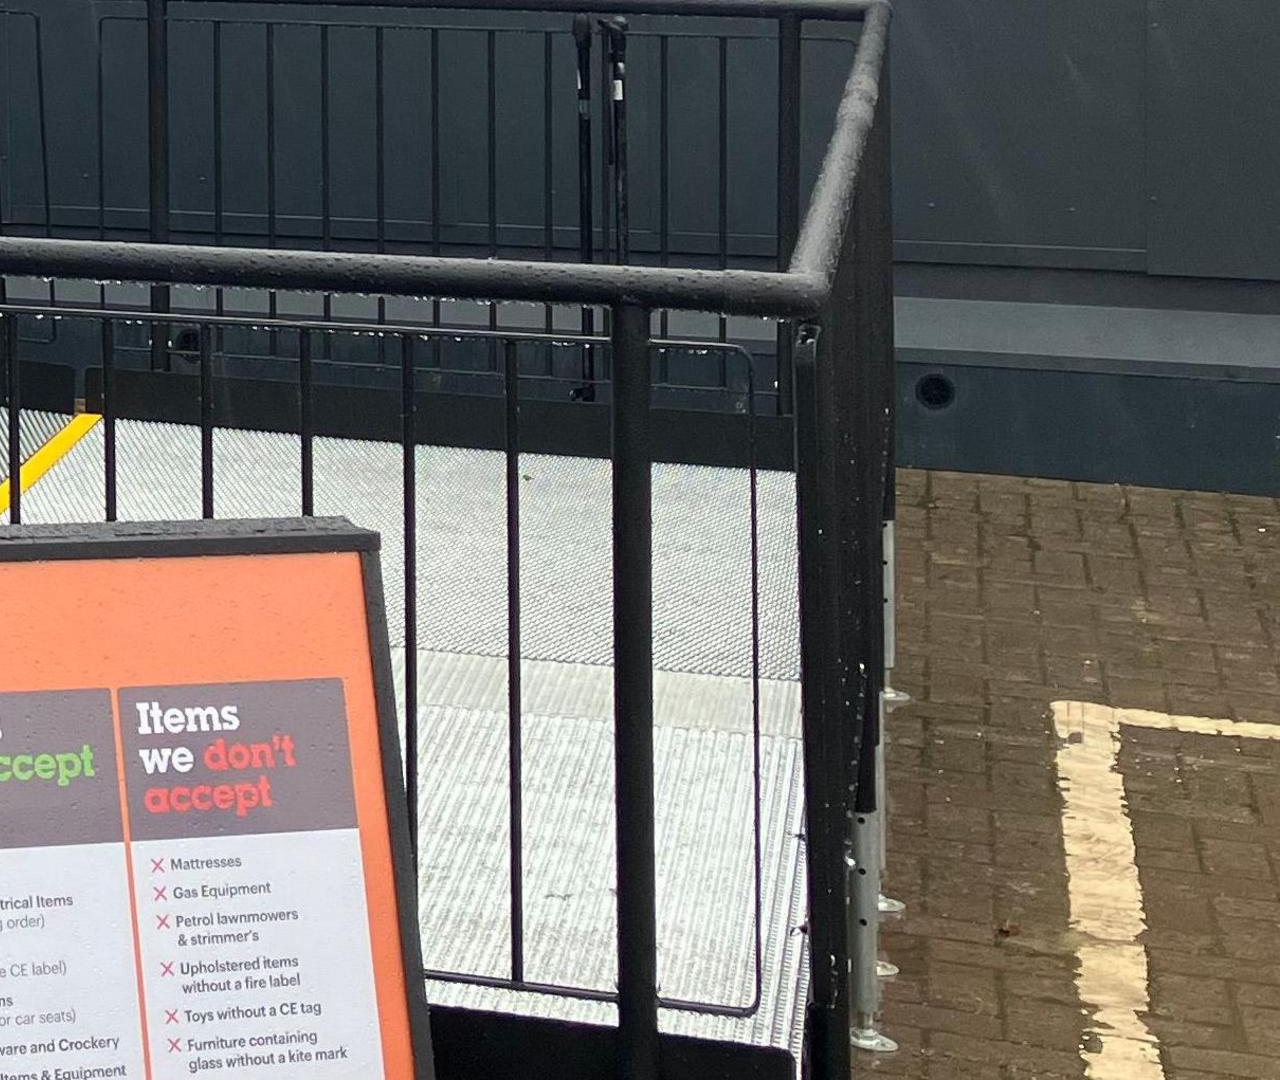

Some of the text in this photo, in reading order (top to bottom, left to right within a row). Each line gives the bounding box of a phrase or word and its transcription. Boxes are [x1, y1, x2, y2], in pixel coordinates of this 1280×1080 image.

[136, 701, 240, 735] Items
[139, 731, 296, 774] we don't
[144, 775, 273, 817] accept
[170, 856, 242, 871] Mattresses
[173, 882, 271, 899] Gas Equipment
[36, 895, 73, 908] Items
[7, 914, 45, 929] order)
[176, 909, 299, 928] Petrol lawnmowers
[178, 930, 259, 946] & strimmer's
[10, 964, 29, 977] CE
[32, 960, 67, 975] label)
[180, 955, 299, 977] Upholstered items
[182, 973, 300, 994] without a fire label
[15, 1014, 35, 1026] car
[39, 1008, 76, 1024] seats)
[184, 1002, 322, 1024] Toys without a CE tag
[30, 1039, 55, 1053] and
[58, 1035, 120, 1052] Crockery
[187, 1031, 318, 1051] Furniture containing
[189, 1046, 348, 1073] glass without a kite mark
[41, 1070, 52, 1080] &
[55, 1065, 127, 1080] Equipment
